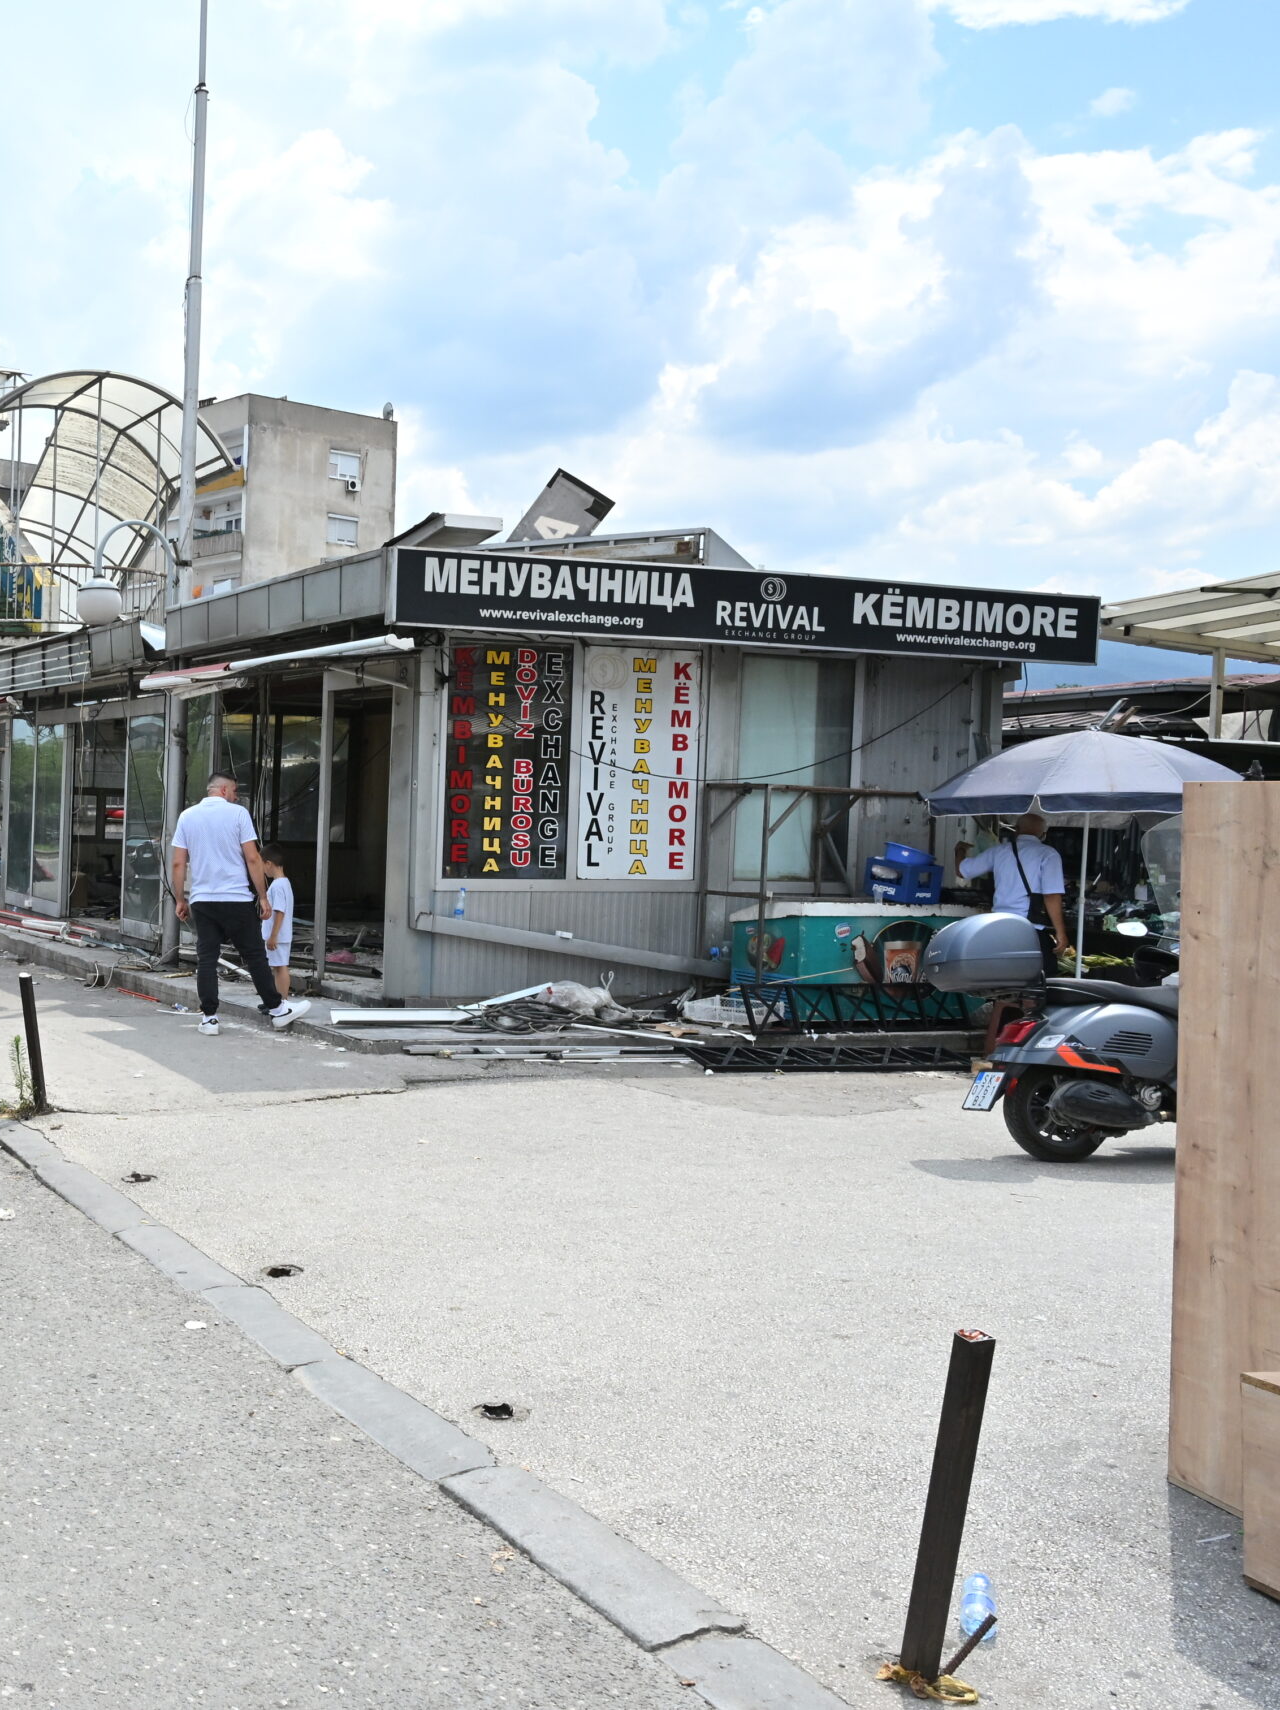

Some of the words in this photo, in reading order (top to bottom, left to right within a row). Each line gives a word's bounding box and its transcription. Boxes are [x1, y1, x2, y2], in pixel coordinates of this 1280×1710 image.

[424, 556, 695, 613] МЕНУВАЧНИЦА
[852, 587, 1079, 639] KËMBIMORE
[479, 608, 645, 629] www.revivalexchange.org
[715, 600, 826, 632] REVIVAL
[724, 629, 777, 639] EXCHANGE
[783, 632, 816, 641] GROUP
[896, 631, 1036, 653] www.revivalexchange.org
[482, 650, 511, 873] МЕНУВАЧНИЦА
[538, 652, 564, 869] EXCHANGE
[609, 703, 618, 790] EXCHANGE
[628, 657, 657, 875] МЕНУВАЧНИЦА
[668, 661, 693, 870] KËMBIMORE
[584, 690, 607, 868] REVIVAL
[510, 758, 534, 868] BÜROSU
[607, 802, 615, 855] GROUP
[872, 883, 896, 895] PEPSI
